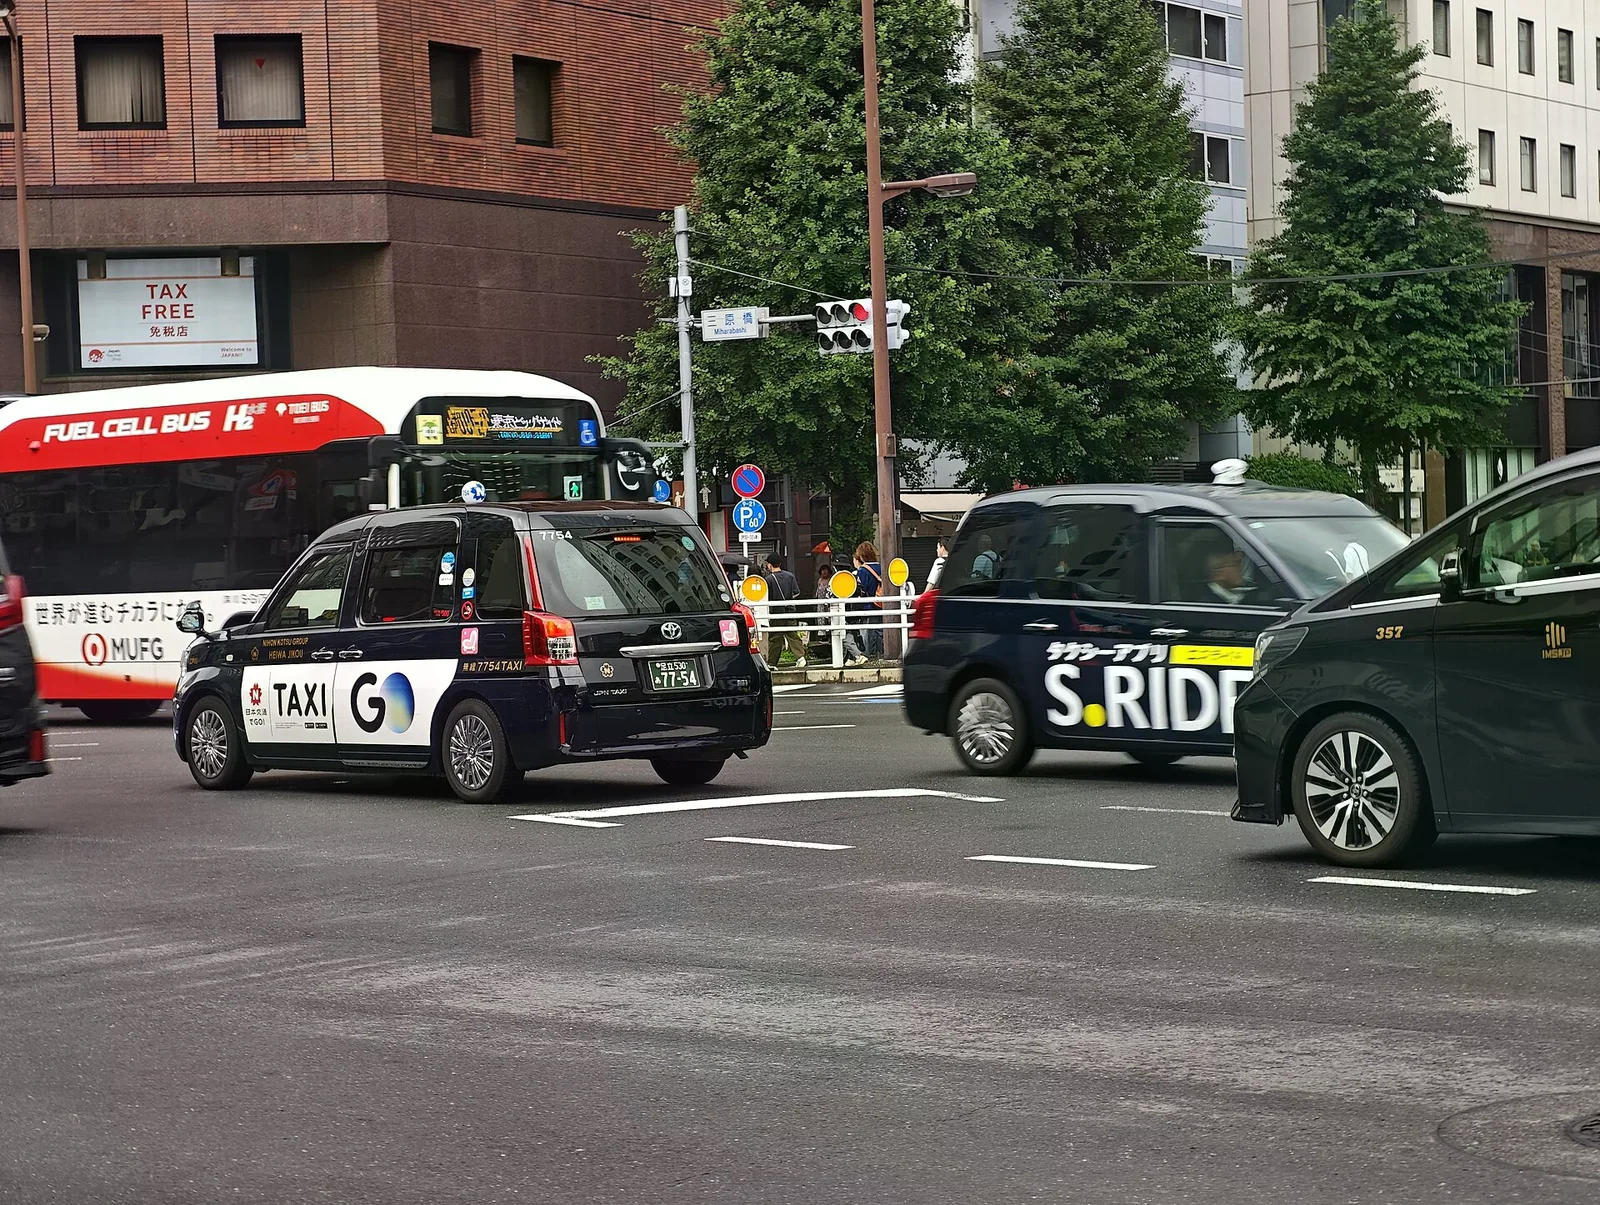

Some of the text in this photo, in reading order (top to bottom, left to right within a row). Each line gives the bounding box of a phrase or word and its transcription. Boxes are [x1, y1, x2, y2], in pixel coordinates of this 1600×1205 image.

[146, 283, 188, 300] TAX
[142, 304, 194, 320] FREE
[707, 311, 753, 327] 三原橋
[150, 326, 188, 338] 免税店
[222, 403, 254, 431] H2
[43, 410, 212, 443] FUEL CELL BUS
[740, 507, 758, 528] P 60
[539, 530, 572, 540] 7754
[36, 600, 213, 627] 世界が進むチカラにな。
[292, 637, 309, 646] GROUP
[1375, 625, 1404, 640] 357
[111, 637, 164, 661] MUFG
[660, 670, 697, 688] 77-54
[273, 682, 327, 717] TAXI
[350, 672, 416, 734] GO
